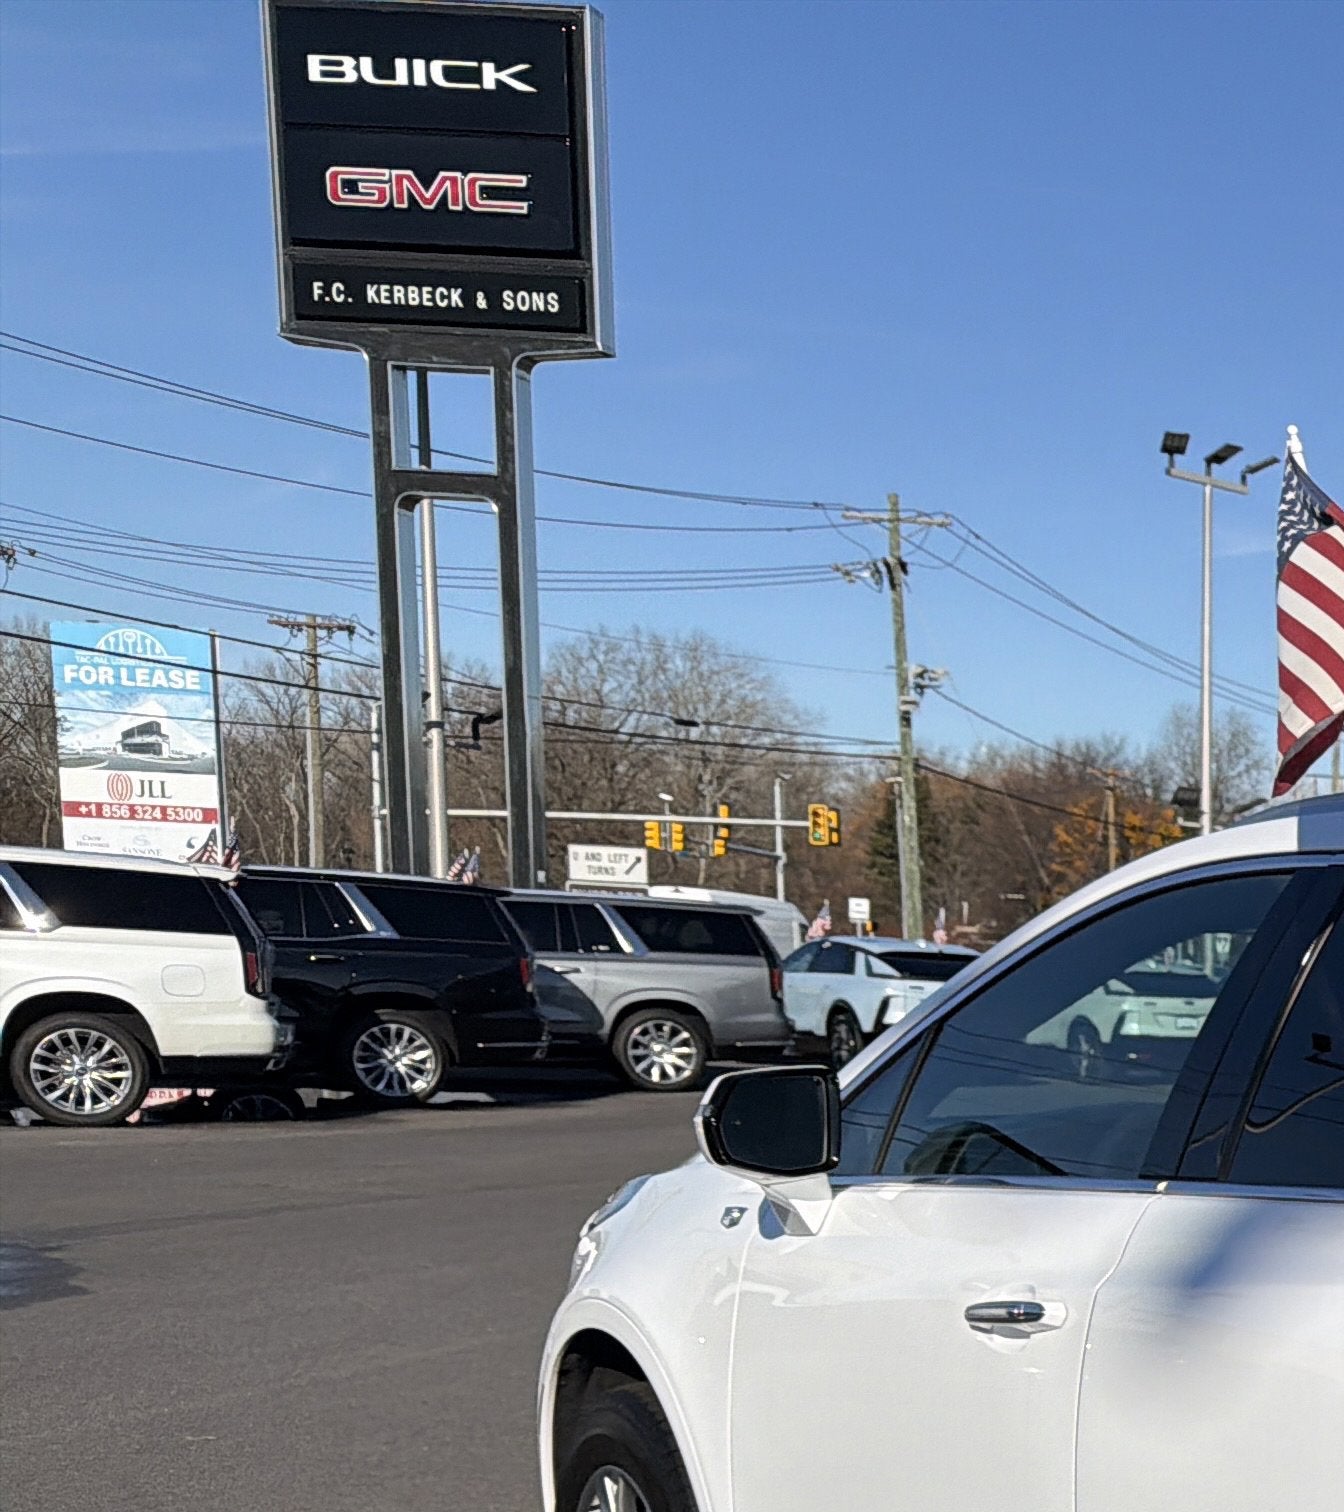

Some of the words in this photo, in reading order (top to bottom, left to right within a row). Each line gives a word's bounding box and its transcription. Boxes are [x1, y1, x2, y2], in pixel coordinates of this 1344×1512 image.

[306, 54, 538, 93] BUICK
[325, 166, 529, 215] GMC
[312, 281, 353, 303] F.C.
[366, 284, 464, 308] KERBECK
[476, 291, 488, 310] &
[503, 290, 560, 313] SONS
[63, 664, 115, 686] FOR
[120, 667, 202, 690] LEASE
[135, 779, 173, 799] JLL
[79, 804, 97, 816] +1
[102, 804, 131, 818] 856
[134, 806, 162, 820] 324
[166, 807, 204, 821] 5300
[585, 851, 602, 863] AND
[607, 852, 629, 864] LEFT
[586, 864, 617, 876] TURNS
